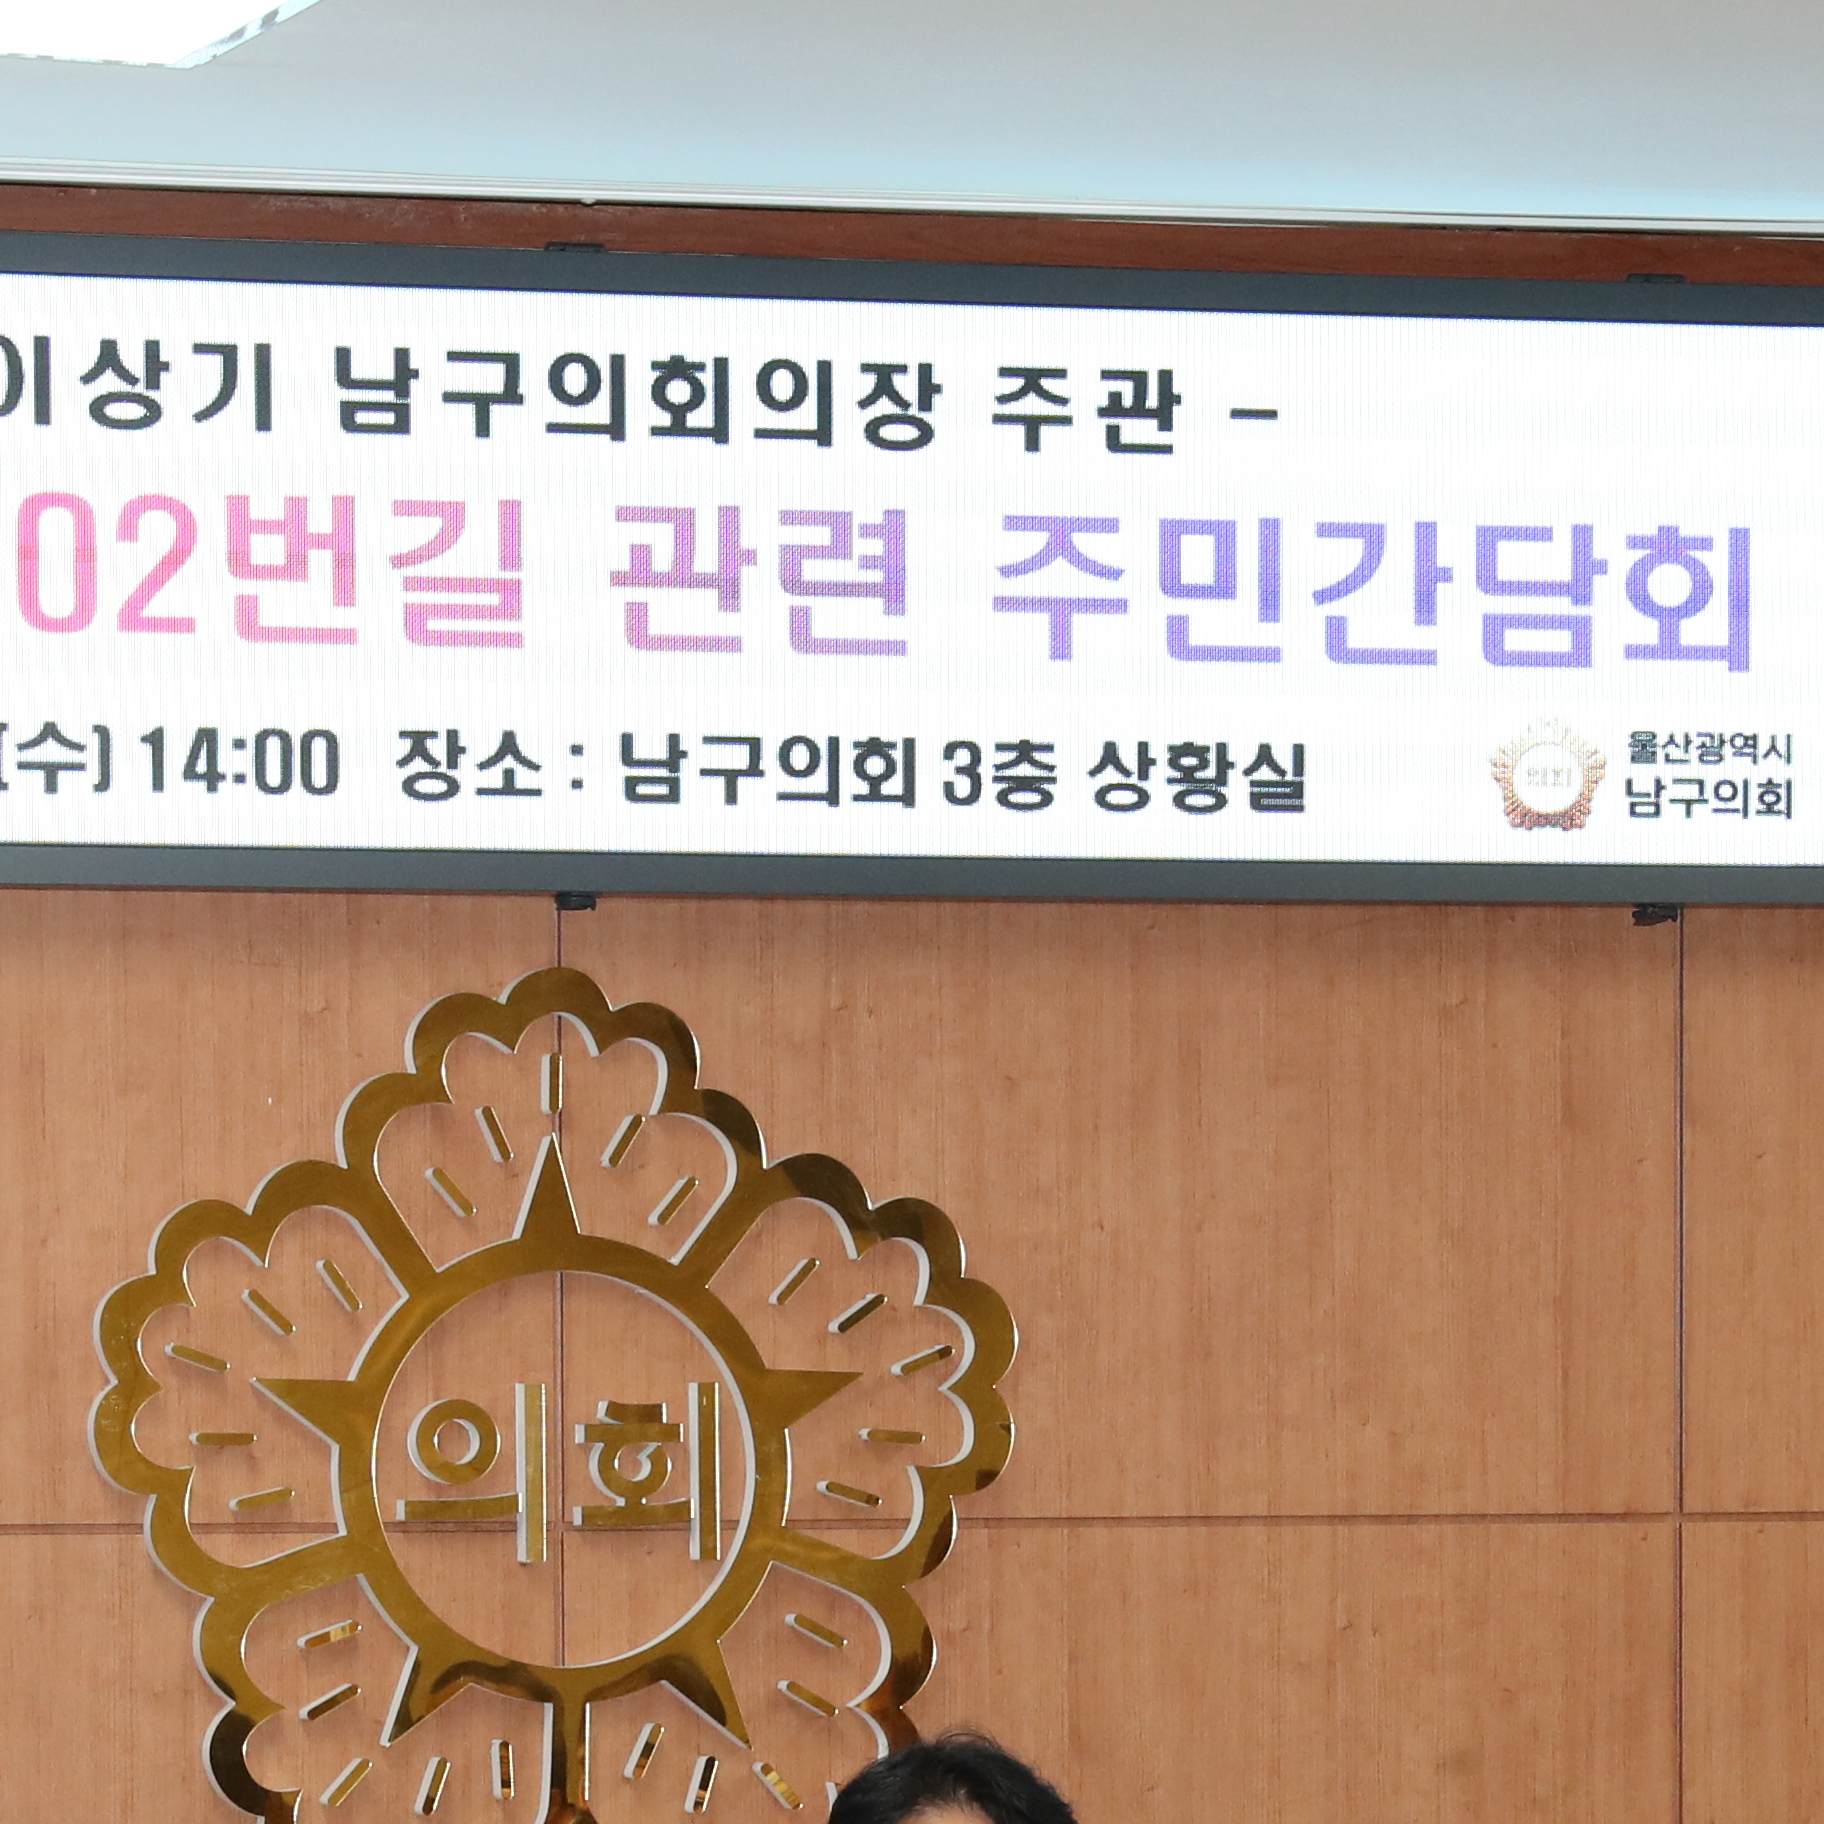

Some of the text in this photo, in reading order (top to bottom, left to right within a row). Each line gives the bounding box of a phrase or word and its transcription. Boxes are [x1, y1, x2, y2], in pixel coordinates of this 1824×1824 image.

[333, 345, 944, 453] 남구의회의장
[990, 365, 1184, 457] 주관
[608, 503, 909, 658] 관련
[991, 513, 1752, 674] 주민간담회
[138, 725, 341, 798] 14:00
[394, 727, 544, 804] 장소
[619, 731, 917, 810] 남구의회
[941, 737, 1059, 814] 3층
[1086, 739, 1307, 816] 상황실
[1627, 729, 1794, 767] 울산광역시
[1623, 775, 1794, 821] 남구의회
[396, 1382, 721, 1563] 의회
